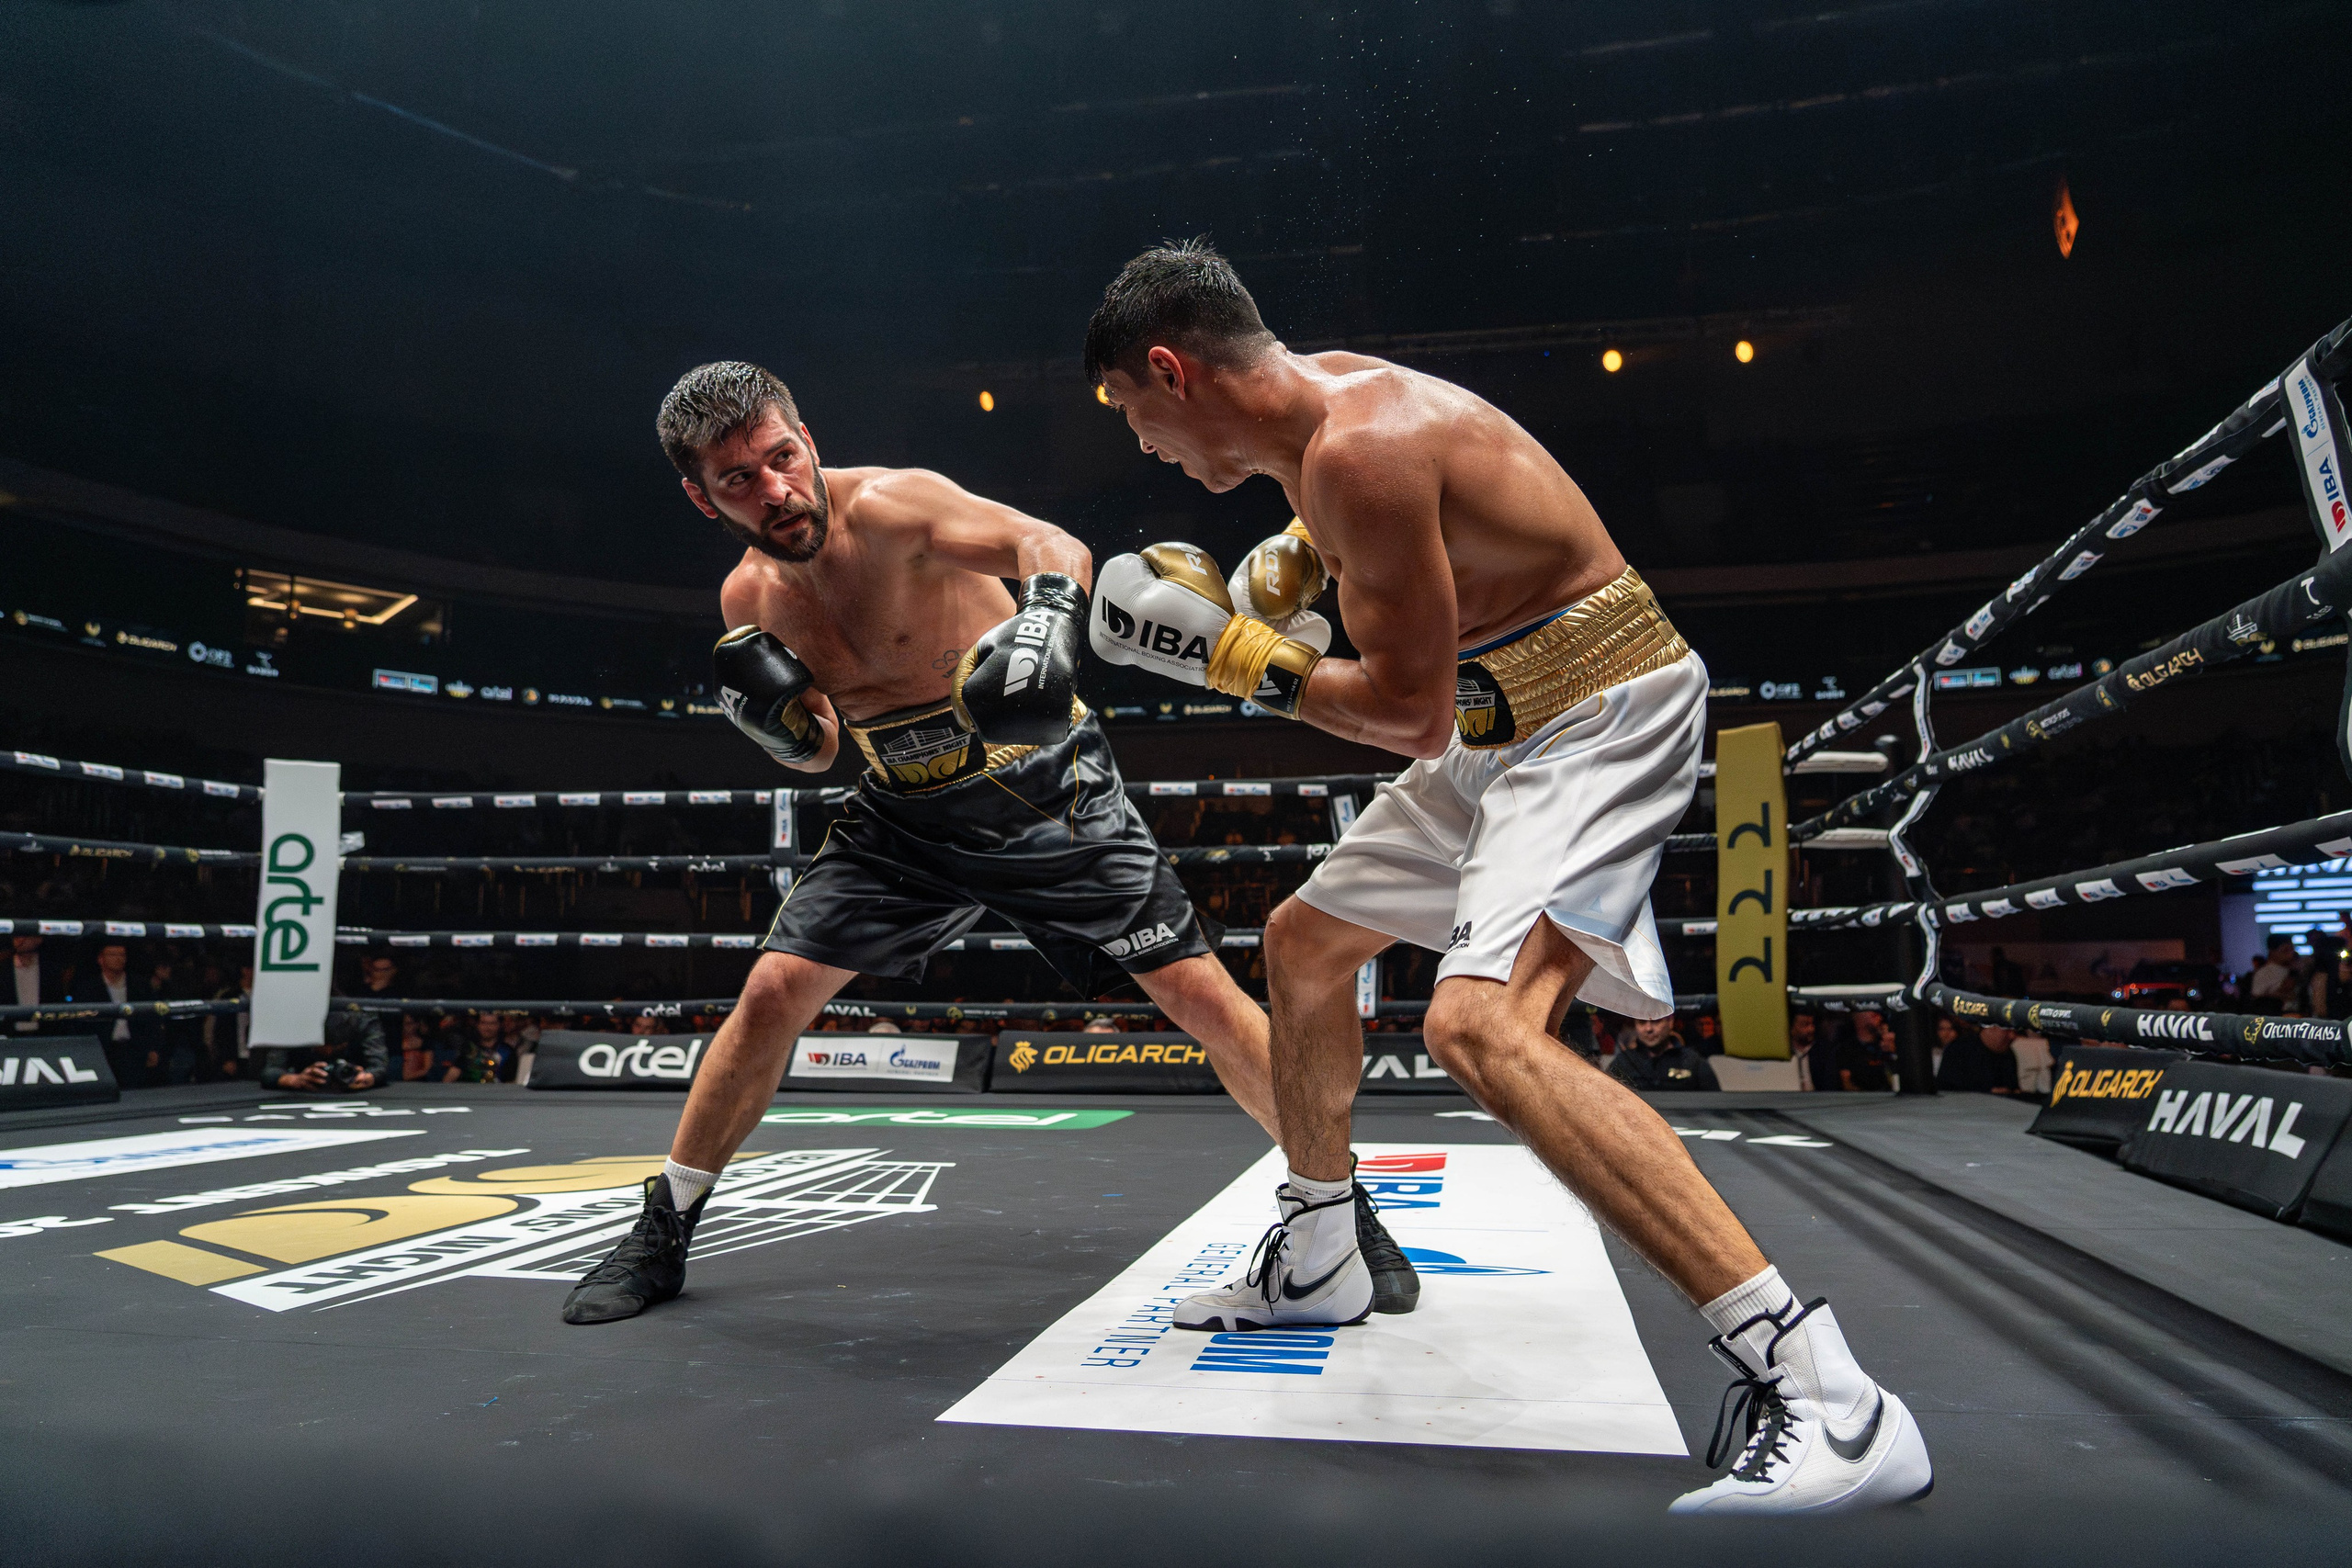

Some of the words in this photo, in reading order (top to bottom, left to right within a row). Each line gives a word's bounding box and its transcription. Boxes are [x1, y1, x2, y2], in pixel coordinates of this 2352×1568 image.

[2319, 456, 2340, 502] IBA
[1014, 611, 1055, 648] IBA
[1139, 619, 1210, 664] IBA
[1038, 645, 1055, 690] INTERNATIONAL
[1099, 631, 1141, 655] INTERNATIONAL
[1141, 650, 1166, 663] BOXING
[1166, 659, 1207, 672] ASSOCIATIO
[1474, 697, 1492, 706] NIGHT
[944, 738, 967, 750] NIGHT
[261, 832, 324, 972] artel
[1129, 922, 1176, 952] IBA
[1448, 920, 1472, 950] BA
[823, 1004, 876, 1018] AVAL
[2136, 1014, 2214, 1041] HAVAL
[578, 1039, 703, 1078] artel
[832, 1053, 867, 1066] IBA
[1043, 1043, 1205, 1066] OLIGARCH
[2067, 1068, 2165, 1100] OLIGARCH
[761, 1111, 1079, 1127] artel
[2147, 1089, 2306, 1160] HAVAL
[264, 1235, 518, 1294] NIGHT
[1162, 1242, 1248, 1291] GENERAL
